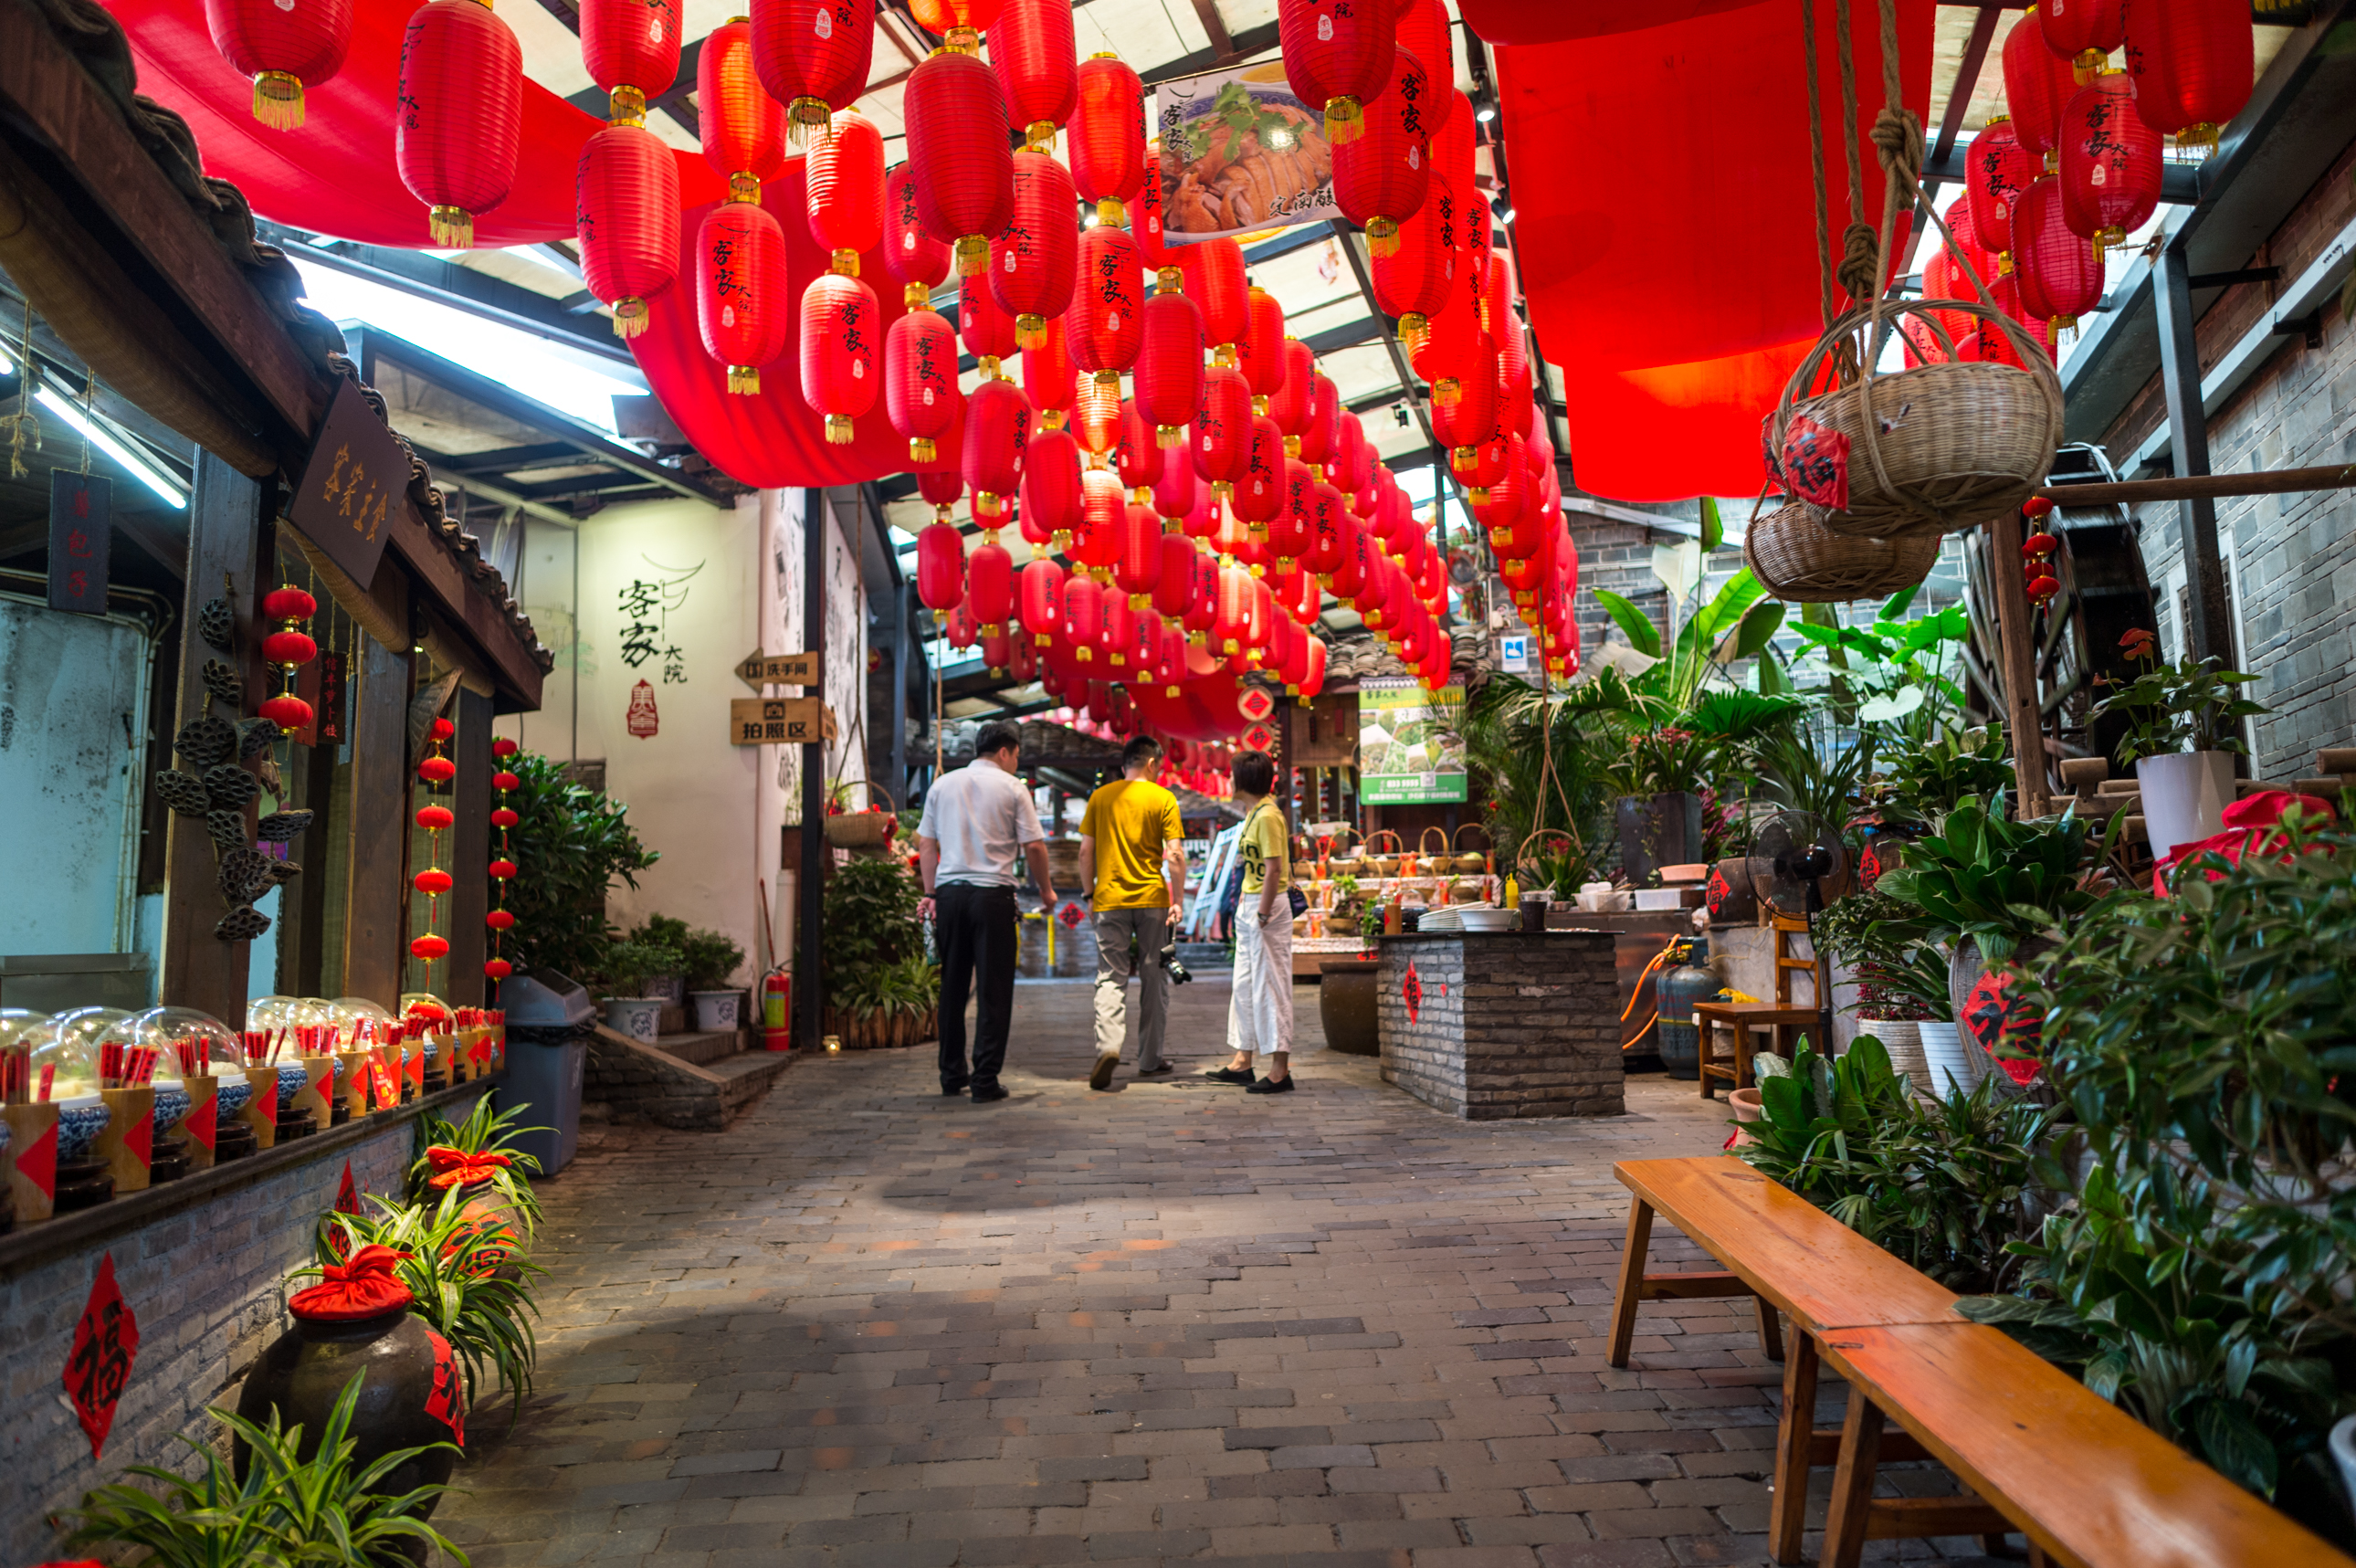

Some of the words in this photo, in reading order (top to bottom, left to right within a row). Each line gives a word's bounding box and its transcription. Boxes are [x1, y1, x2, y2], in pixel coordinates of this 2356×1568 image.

[2085, 104, 2129, 171] 客家大院
[712, 239, 752, 313] 客家大院
[1099, 254, 1132, 320] 客家大院
[841, 303, 872, 371] 客家大院
[915, 337, 947, 396] 客家大院
[618, 580, 688, 685] 客家大院
[767, 662, 807, 676] 洗手间
[743, 721, 806, 739] 拍照区
[1708, 879, 1723, 906] 福
[74, 1300, 128, 1415] 福
